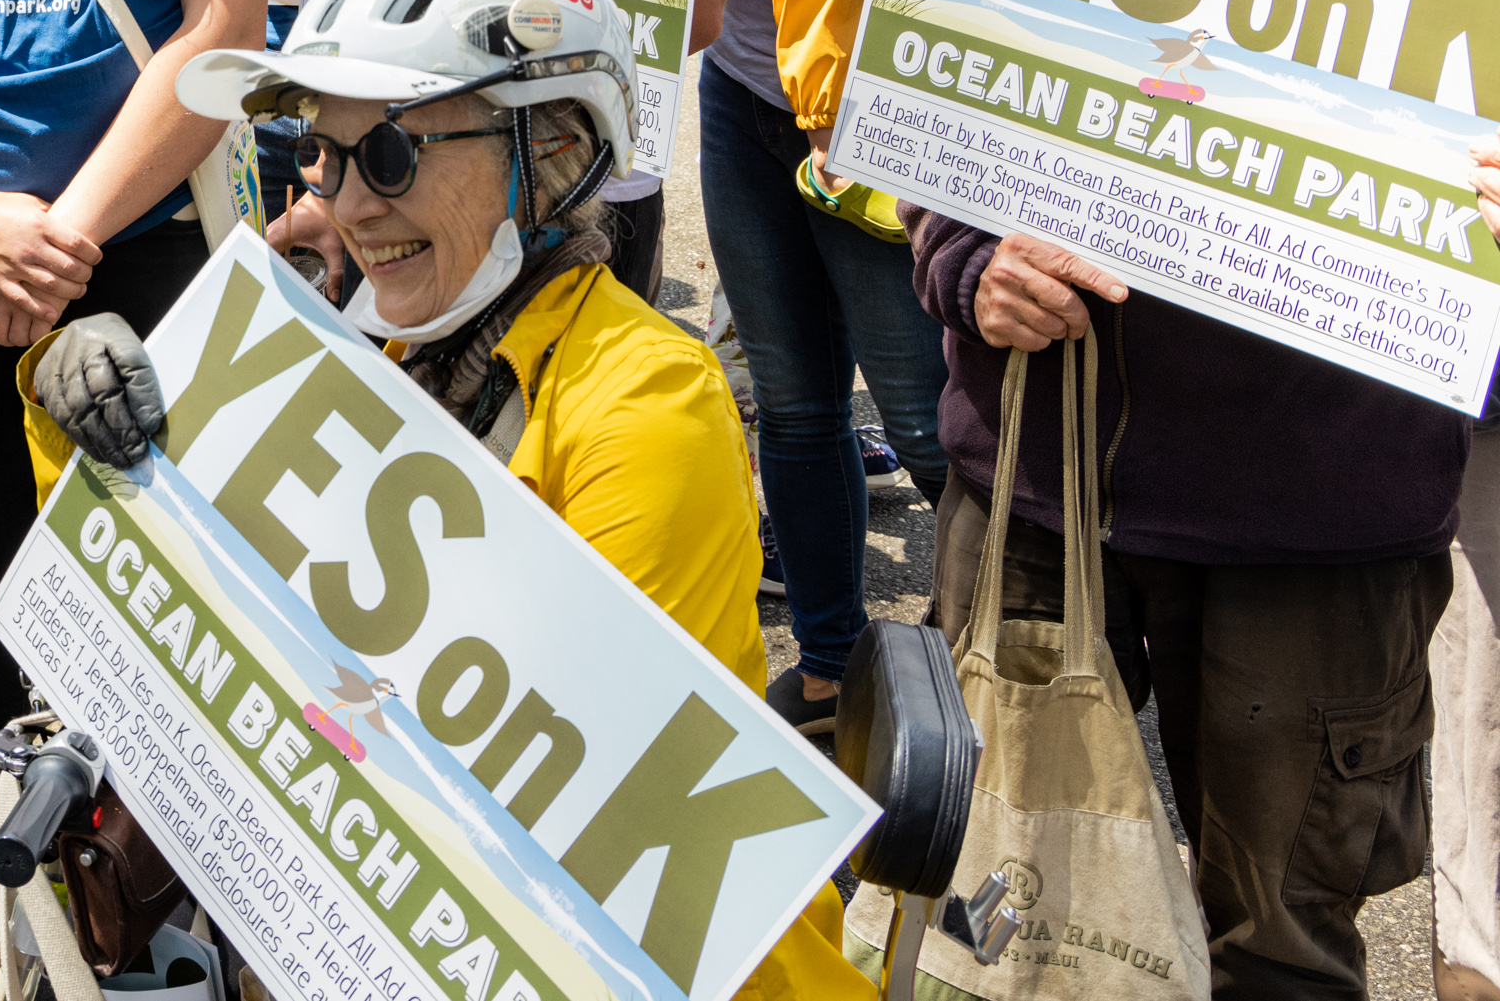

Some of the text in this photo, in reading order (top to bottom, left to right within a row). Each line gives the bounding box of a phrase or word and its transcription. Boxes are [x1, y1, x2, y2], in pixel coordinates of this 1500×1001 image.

[641, 82, 661, 108] Top
[893, 31, 1483, 263] OCEAN BEACH PARK
[232, 167, 249, 216] BIKE
[857, 116, 1470, 356] Funders: 1. Jeremy Stoppelman ($300,000), 2. Heidi Moseson ($10,000),
[153, 259, 830, 998] YES on K
[79, 507, 541, 1001] OCEAN BEACH PA
[1035, 951, 1079, 969] MAUI
[1063, 922, 1173, 980] RANCH
